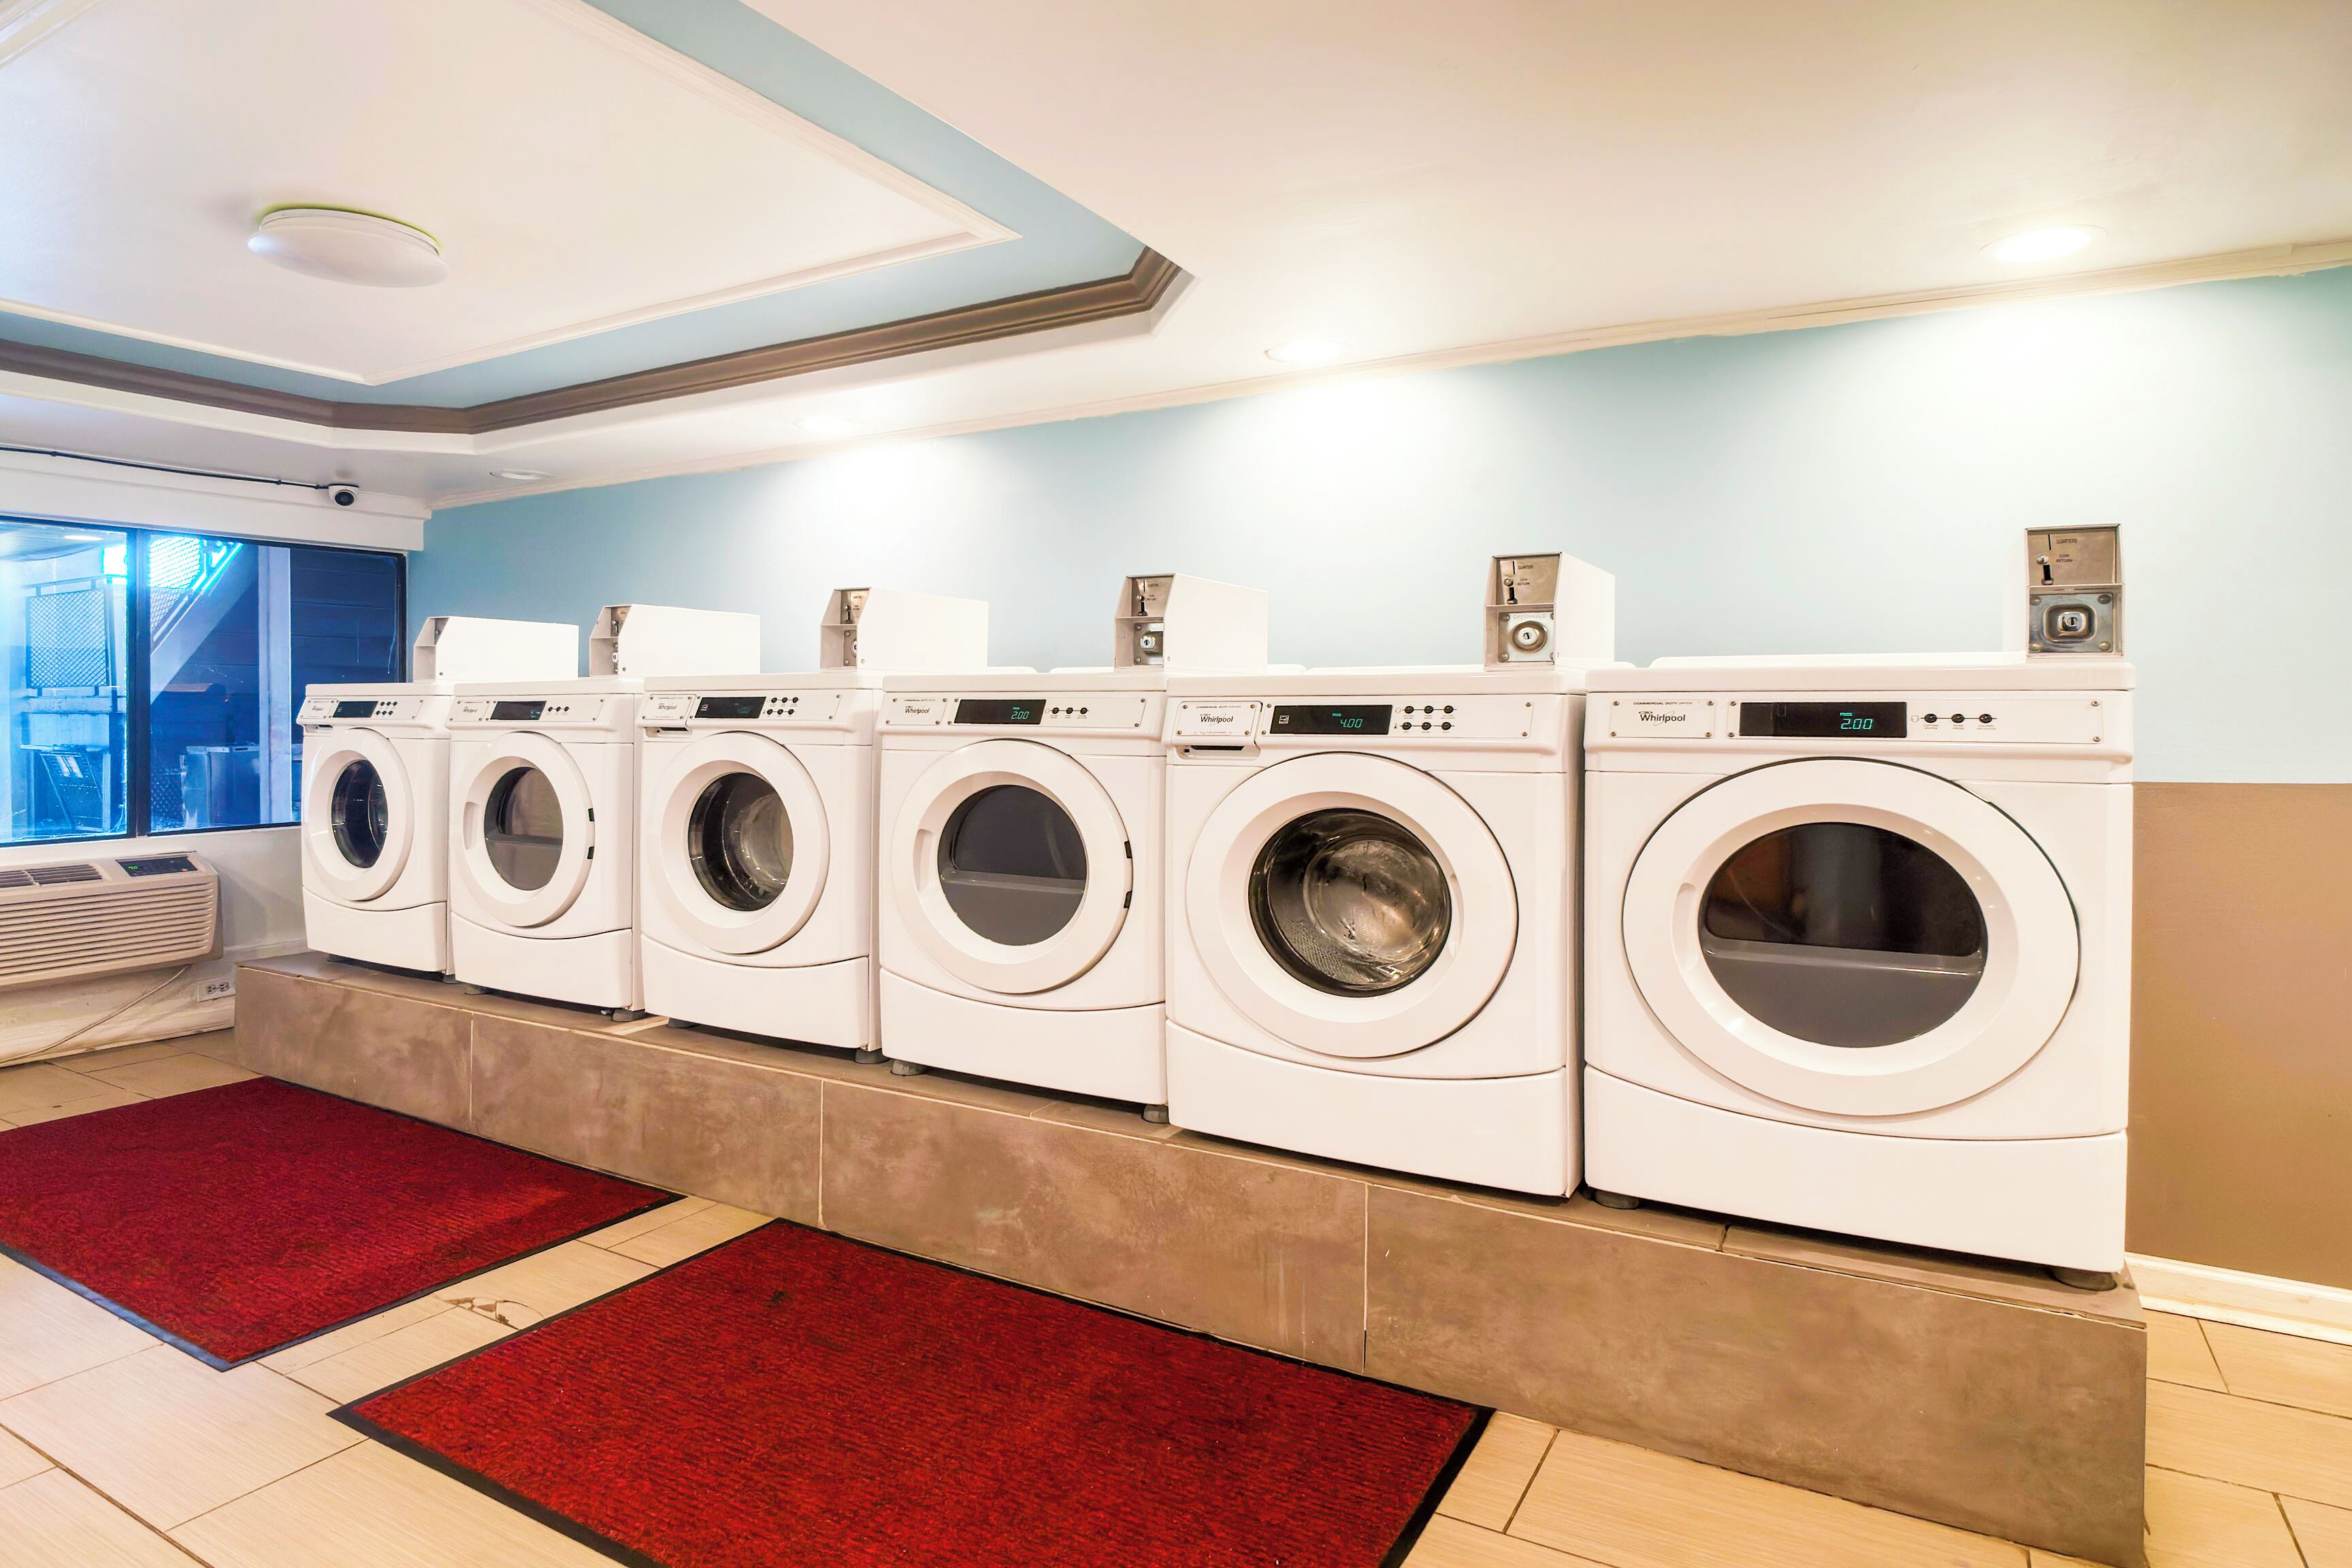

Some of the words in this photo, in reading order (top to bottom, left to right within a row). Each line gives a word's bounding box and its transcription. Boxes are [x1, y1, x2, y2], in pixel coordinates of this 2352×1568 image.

[1011, 711, 1029, 719] 2.00
[1639, 714, 1686, 723] Whirlpool
[1340, 719, 1363, 728] 4.00
[1841, 719, 1873, 730] 2.00
